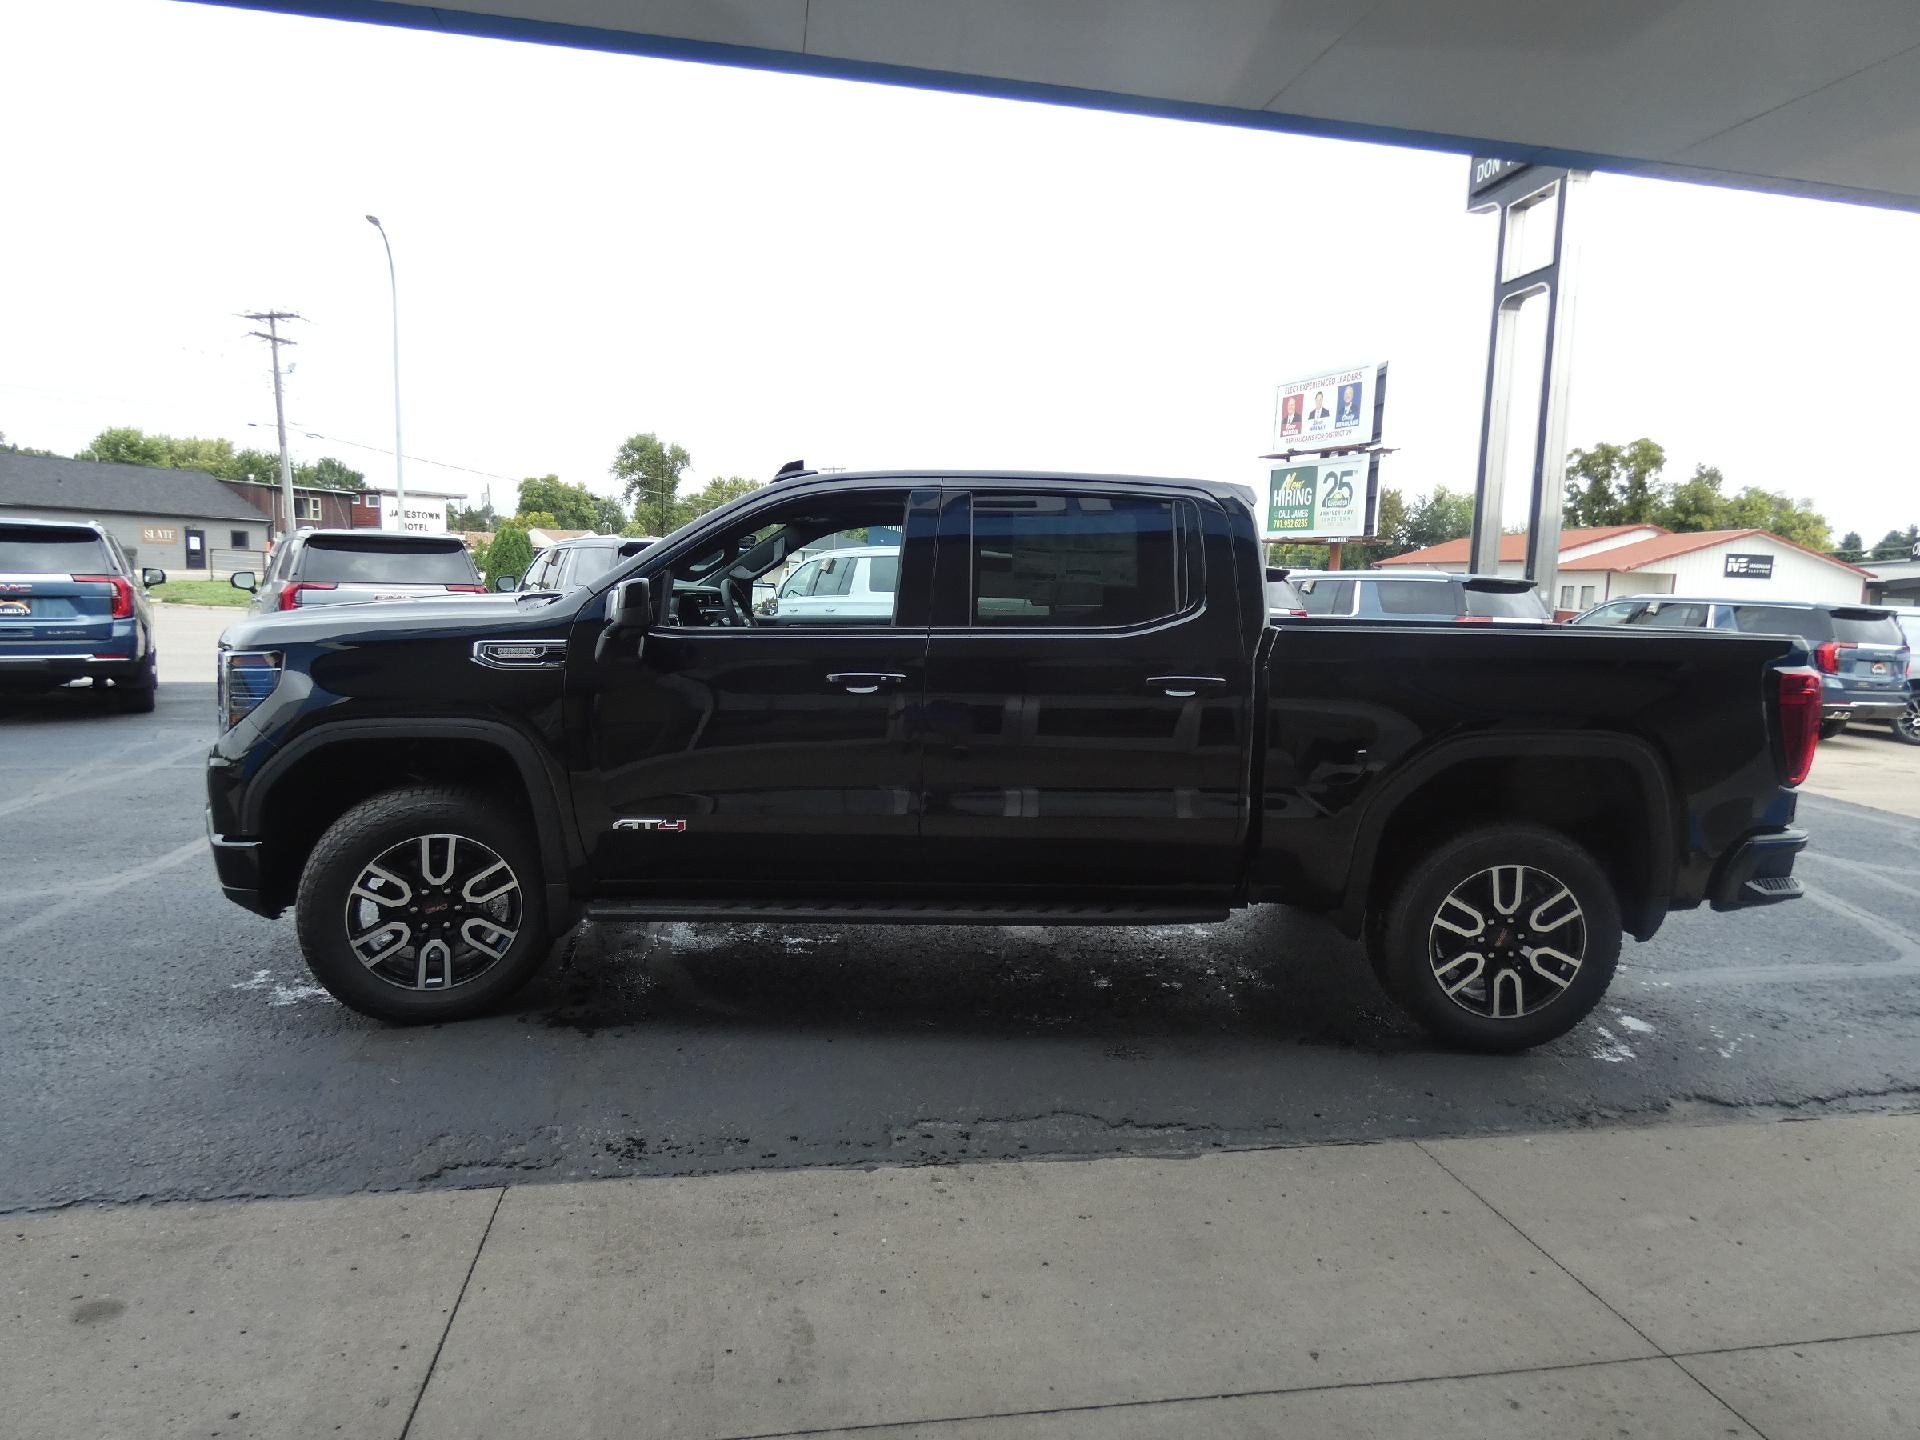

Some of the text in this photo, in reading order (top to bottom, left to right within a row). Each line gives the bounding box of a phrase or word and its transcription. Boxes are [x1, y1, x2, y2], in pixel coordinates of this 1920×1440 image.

[1476, 159, 1500, 182] DON
[1281, 472, 1304, 490] Now
[1273, 487, 1313, 507] HIRING
[1278, 509, 1309, 519] CALL JAMES
[612, 819, 687, 833] AT4
